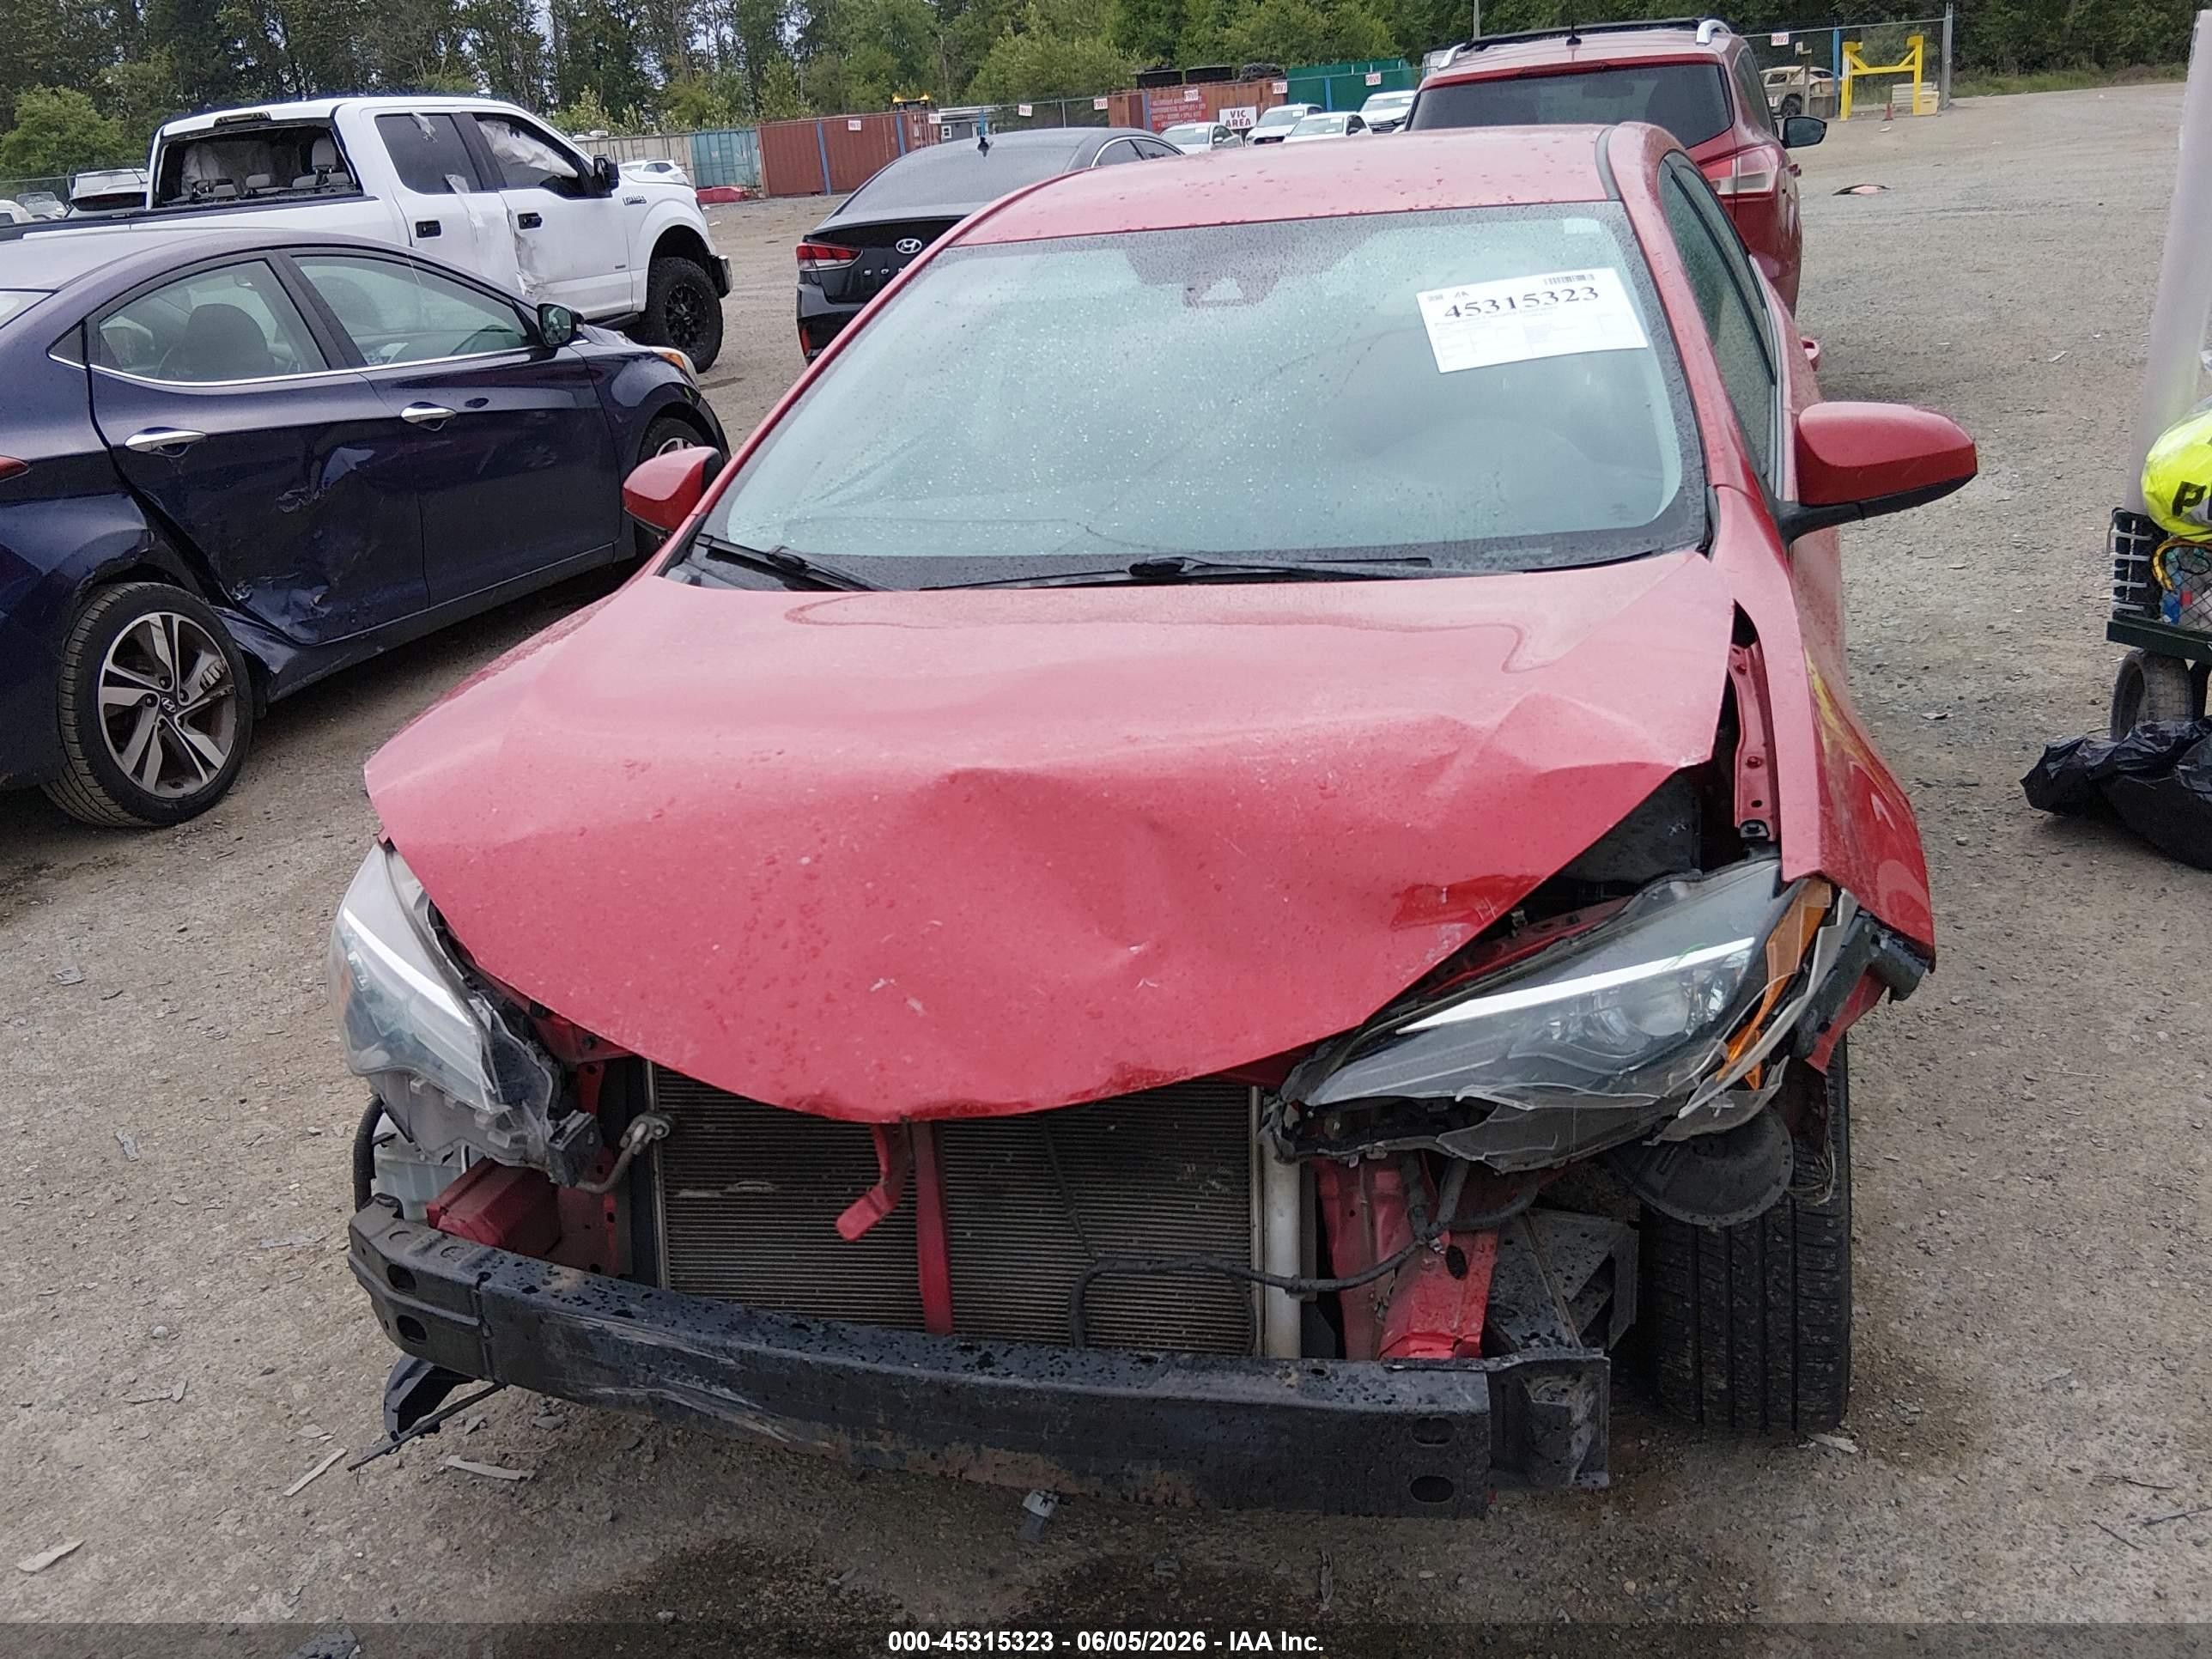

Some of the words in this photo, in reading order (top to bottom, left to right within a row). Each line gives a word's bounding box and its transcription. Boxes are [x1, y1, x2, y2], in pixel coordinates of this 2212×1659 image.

[1224, 118, 1252, 128] AREA
[1230, 109, 1247, 118] VIC
[1443, 285, 1600, 319] 45315323
[2172, 480, 2212, 521] P
